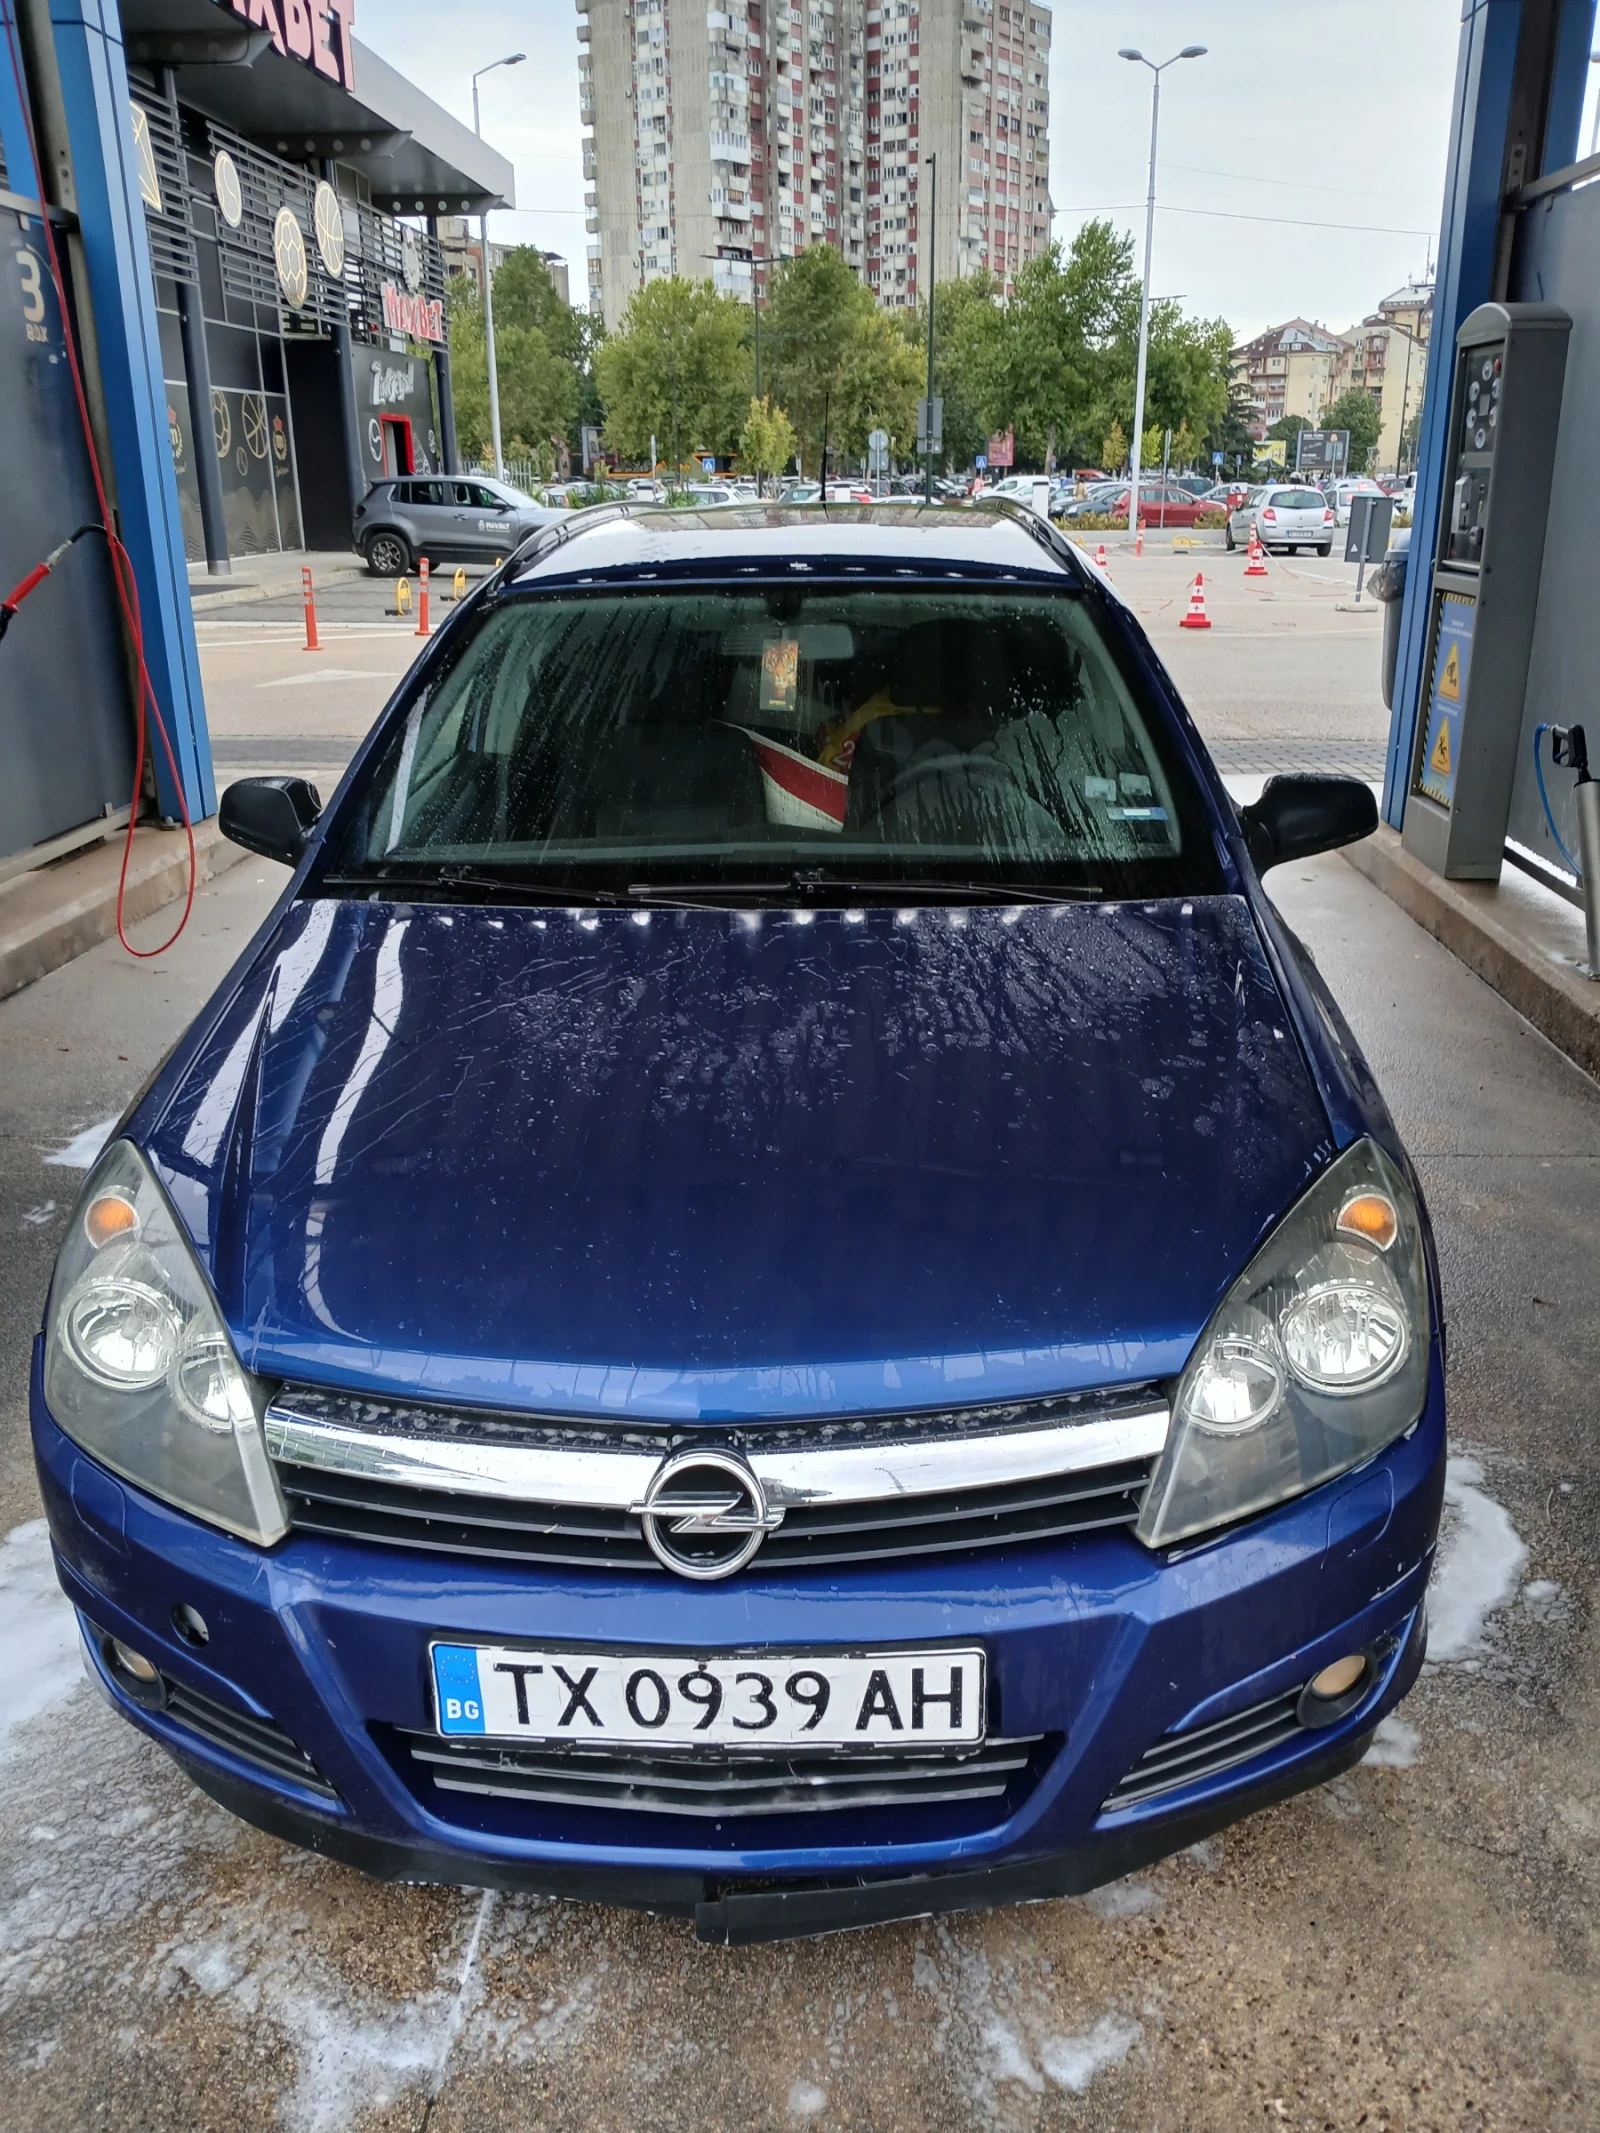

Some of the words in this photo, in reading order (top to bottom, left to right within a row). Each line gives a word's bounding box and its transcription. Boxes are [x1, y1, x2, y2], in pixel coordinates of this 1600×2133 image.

[16, 250, 45, 323] 3
[383, 283, 443, 344] MAXBET
[26, 323, 48, 343] BOX
[446, 1697, 480, 1721] BG
[493, 1661, 606, 1727] TX
[625, 1668, 831, 1731] 0939
[855, 1665, 964, 1731] AH
